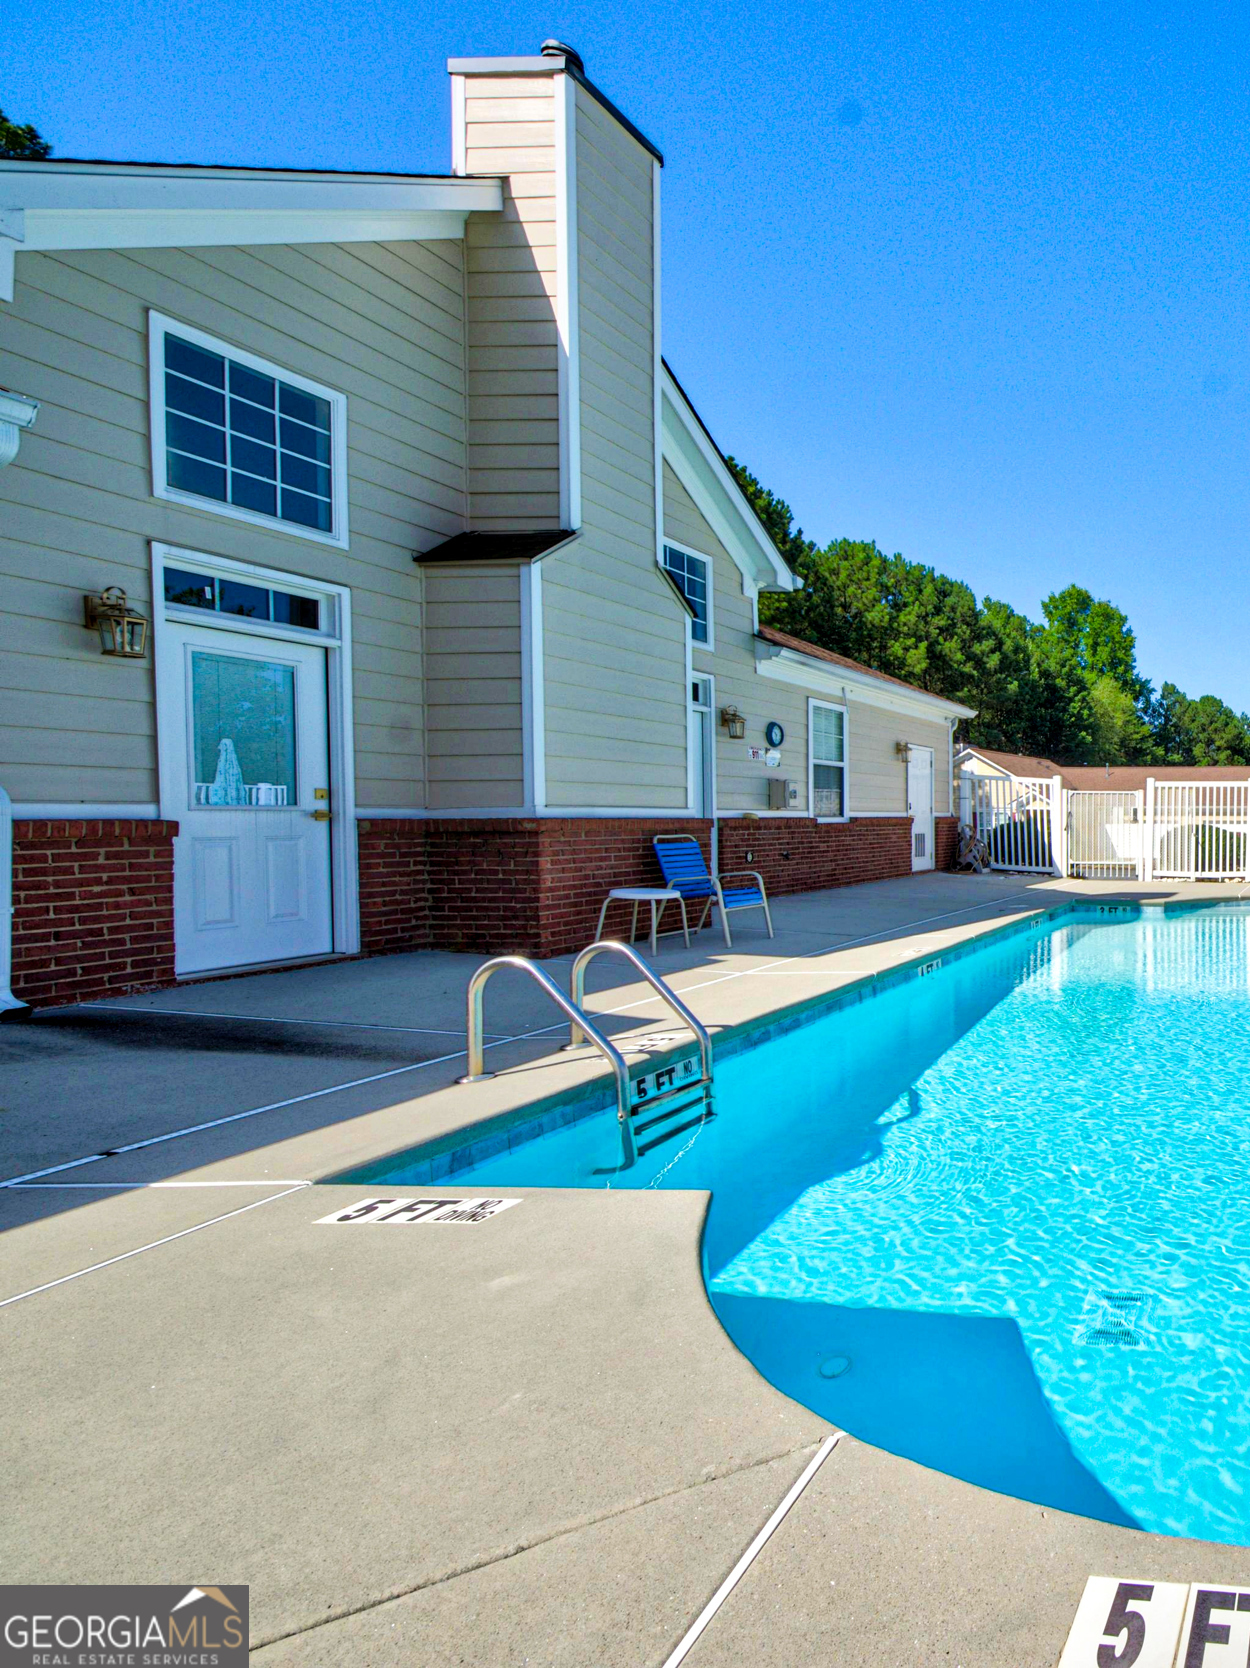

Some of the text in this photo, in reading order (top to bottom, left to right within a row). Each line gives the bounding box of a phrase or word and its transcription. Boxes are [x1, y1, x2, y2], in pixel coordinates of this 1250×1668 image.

[683, 1060, 693, 1075] NO
[636, 1066, 676, 1099] 5 FT
[336, 1199, 463, 1222] 5 FT
[469, 1199, 504, 1210] NO
[433, 1209, 495, 1222] DIVING
[1096, 1582, 1155, 1668] 5
